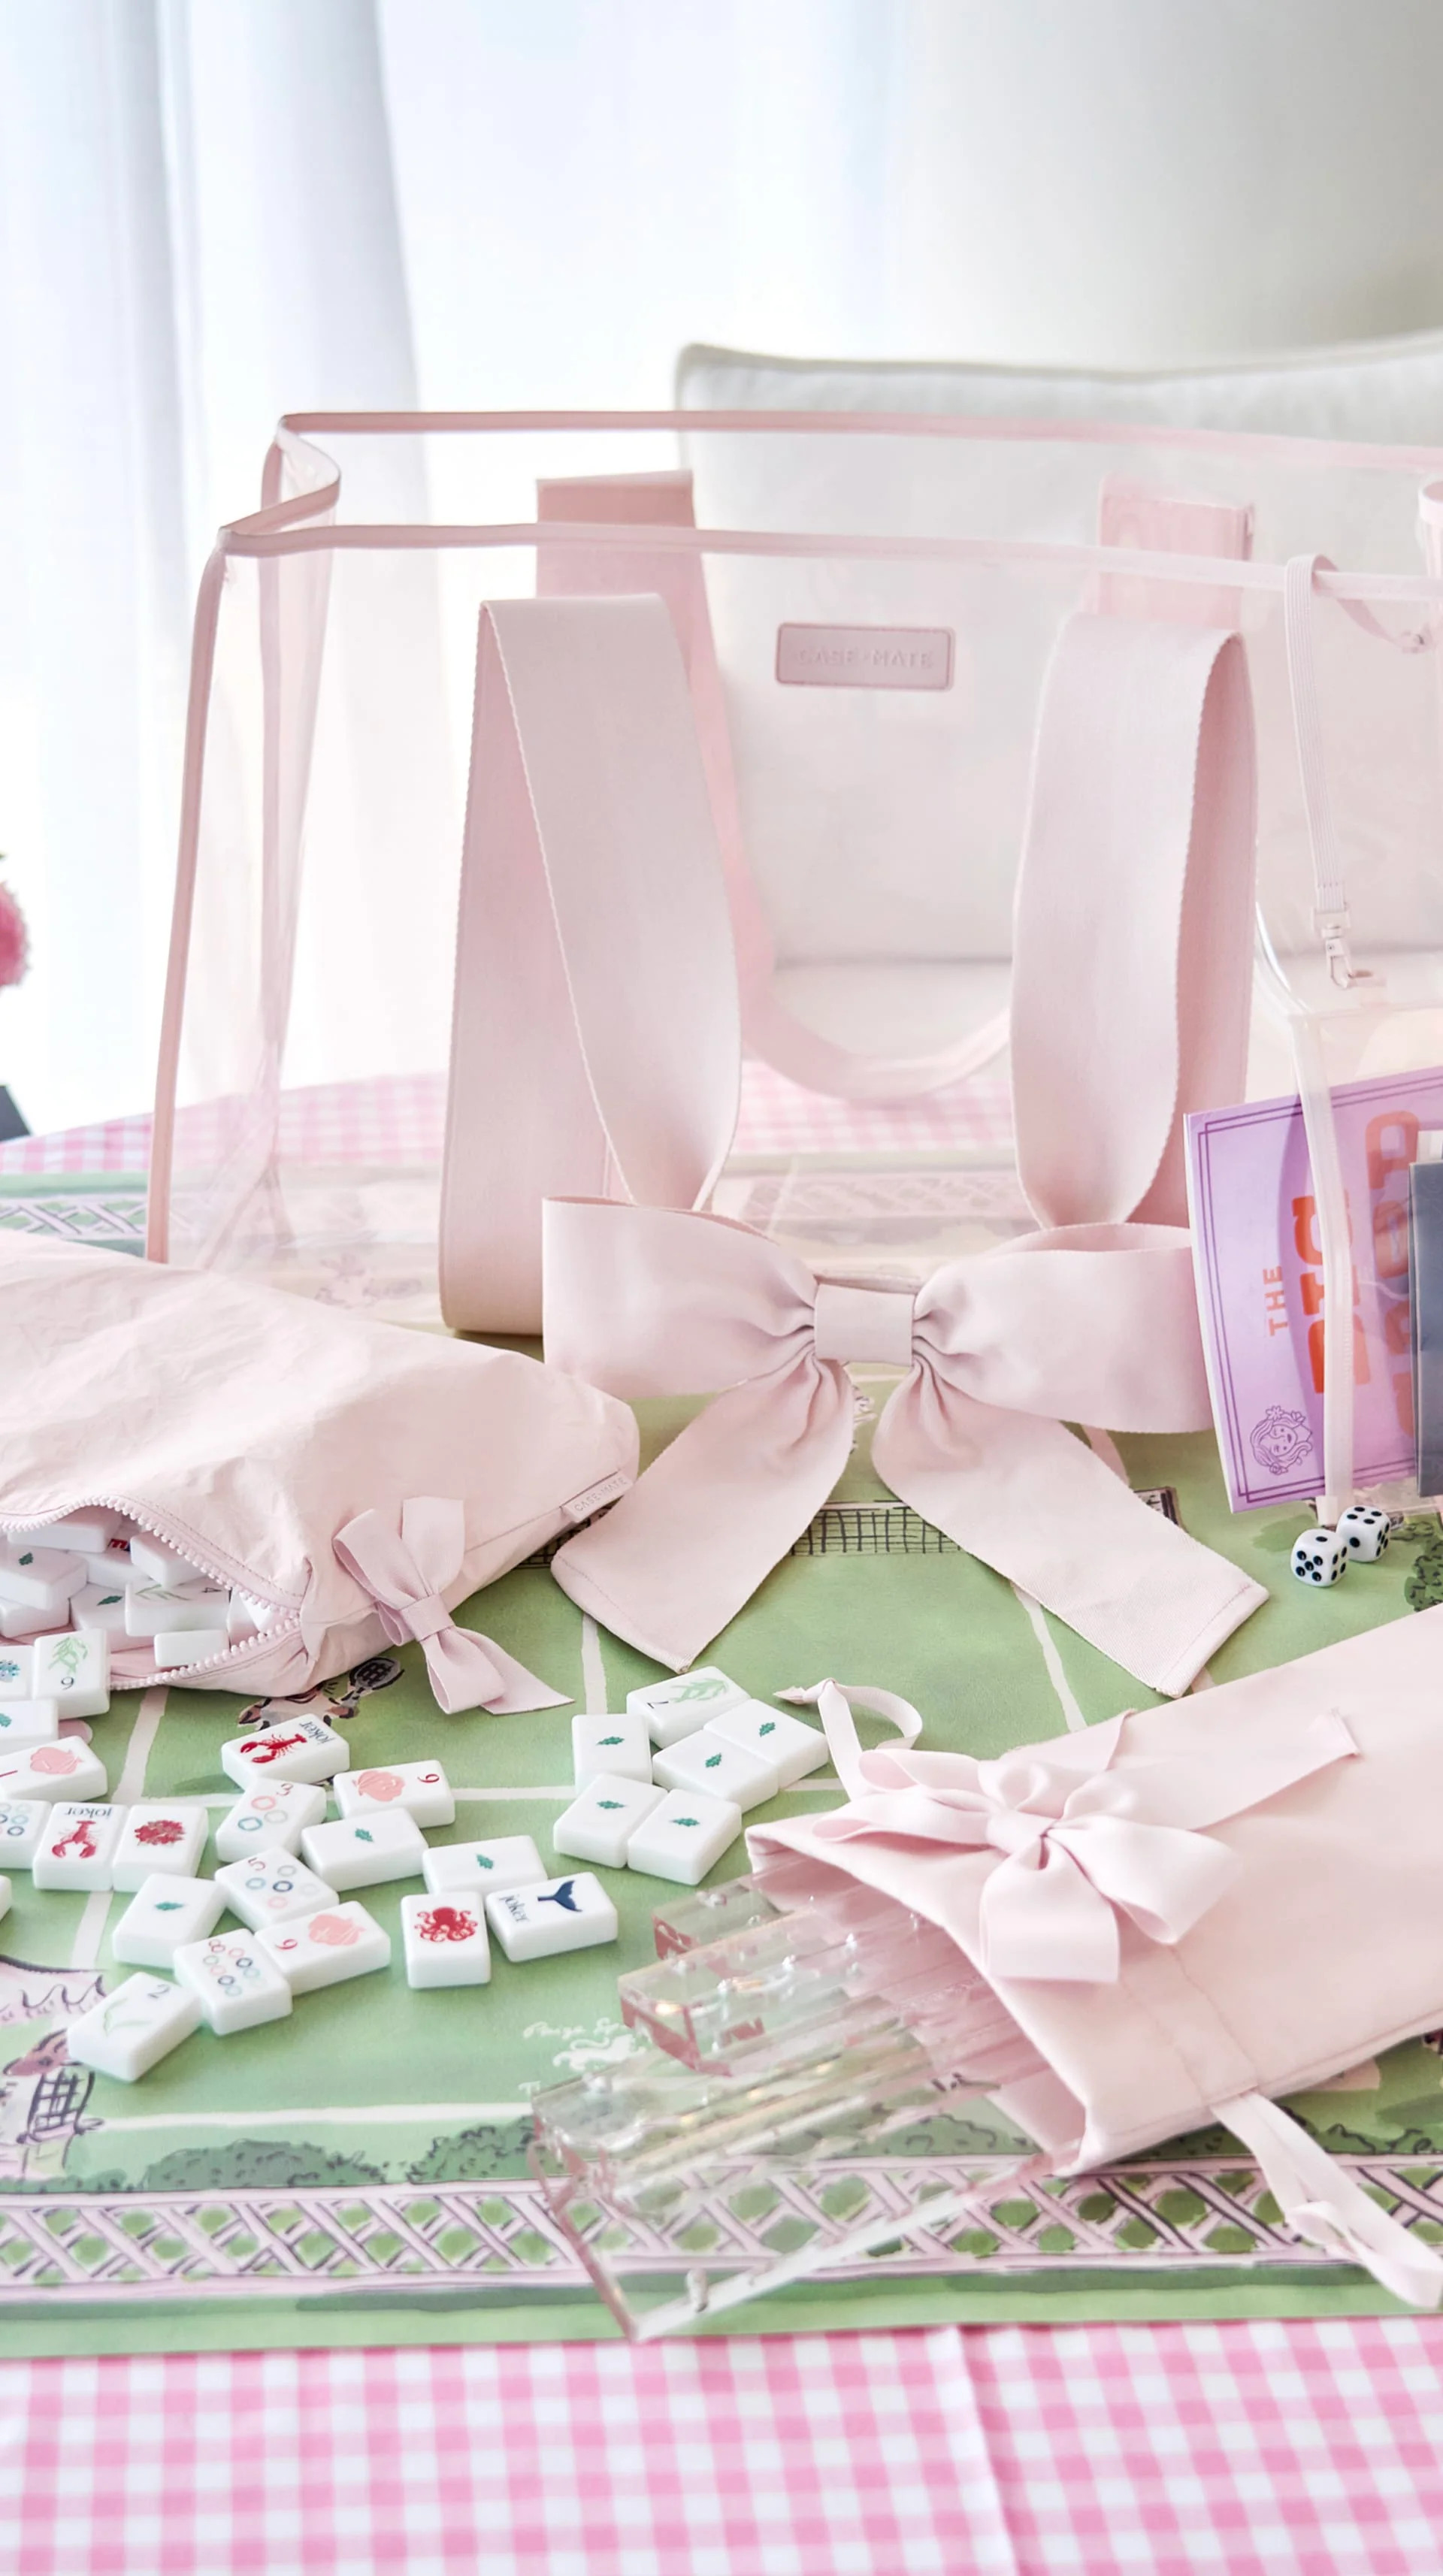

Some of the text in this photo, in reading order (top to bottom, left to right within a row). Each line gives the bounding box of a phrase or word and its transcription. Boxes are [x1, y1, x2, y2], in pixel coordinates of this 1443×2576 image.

[1262, 1265, 1288, 1336] THE
[298, 1720, 336, 1746] joker
[276, 1782, 294, 1797] 3
[65, 1806, 113, 1819] joker
[247, 1857, 266, 1871] 5
[498, 1893, 531, 1923] joker
[208, 1938, 226, 1953] 8
[147, 1982, 171, 1999] 2
